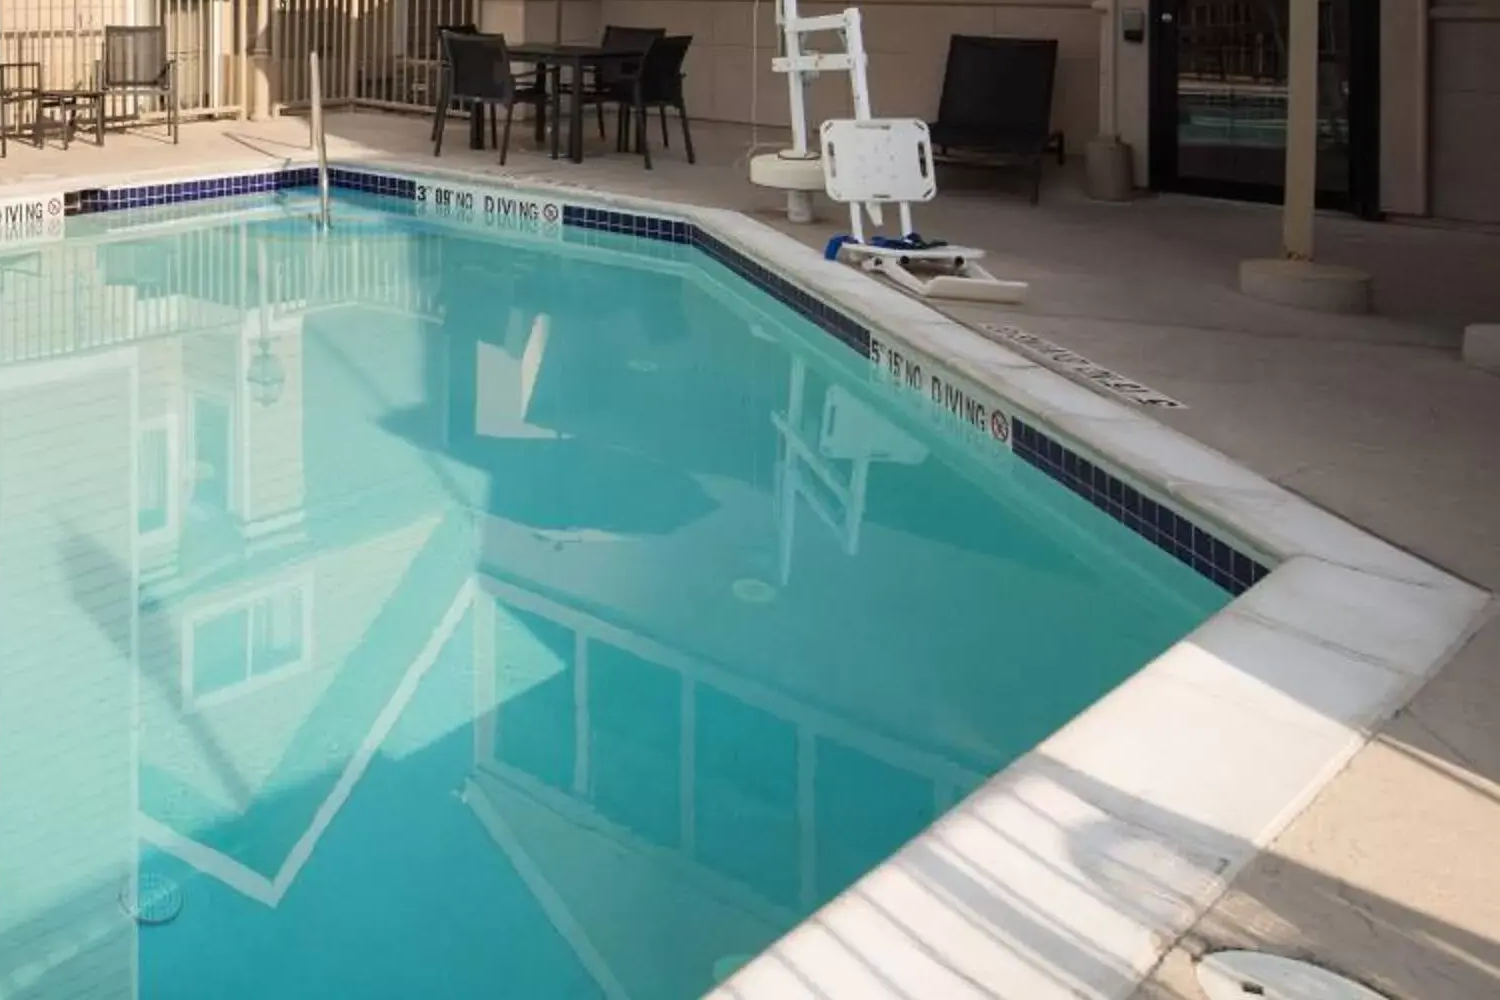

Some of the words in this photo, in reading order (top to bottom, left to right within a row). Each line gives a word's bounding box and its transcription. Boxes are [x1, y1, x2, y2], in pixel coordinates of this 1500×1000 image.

[456, 191, 473, 209] NO
[484, 195, 540, 220] DIVING
[905, 359, 922, 388] NO
[931, 375, 986, 433] DIVING
